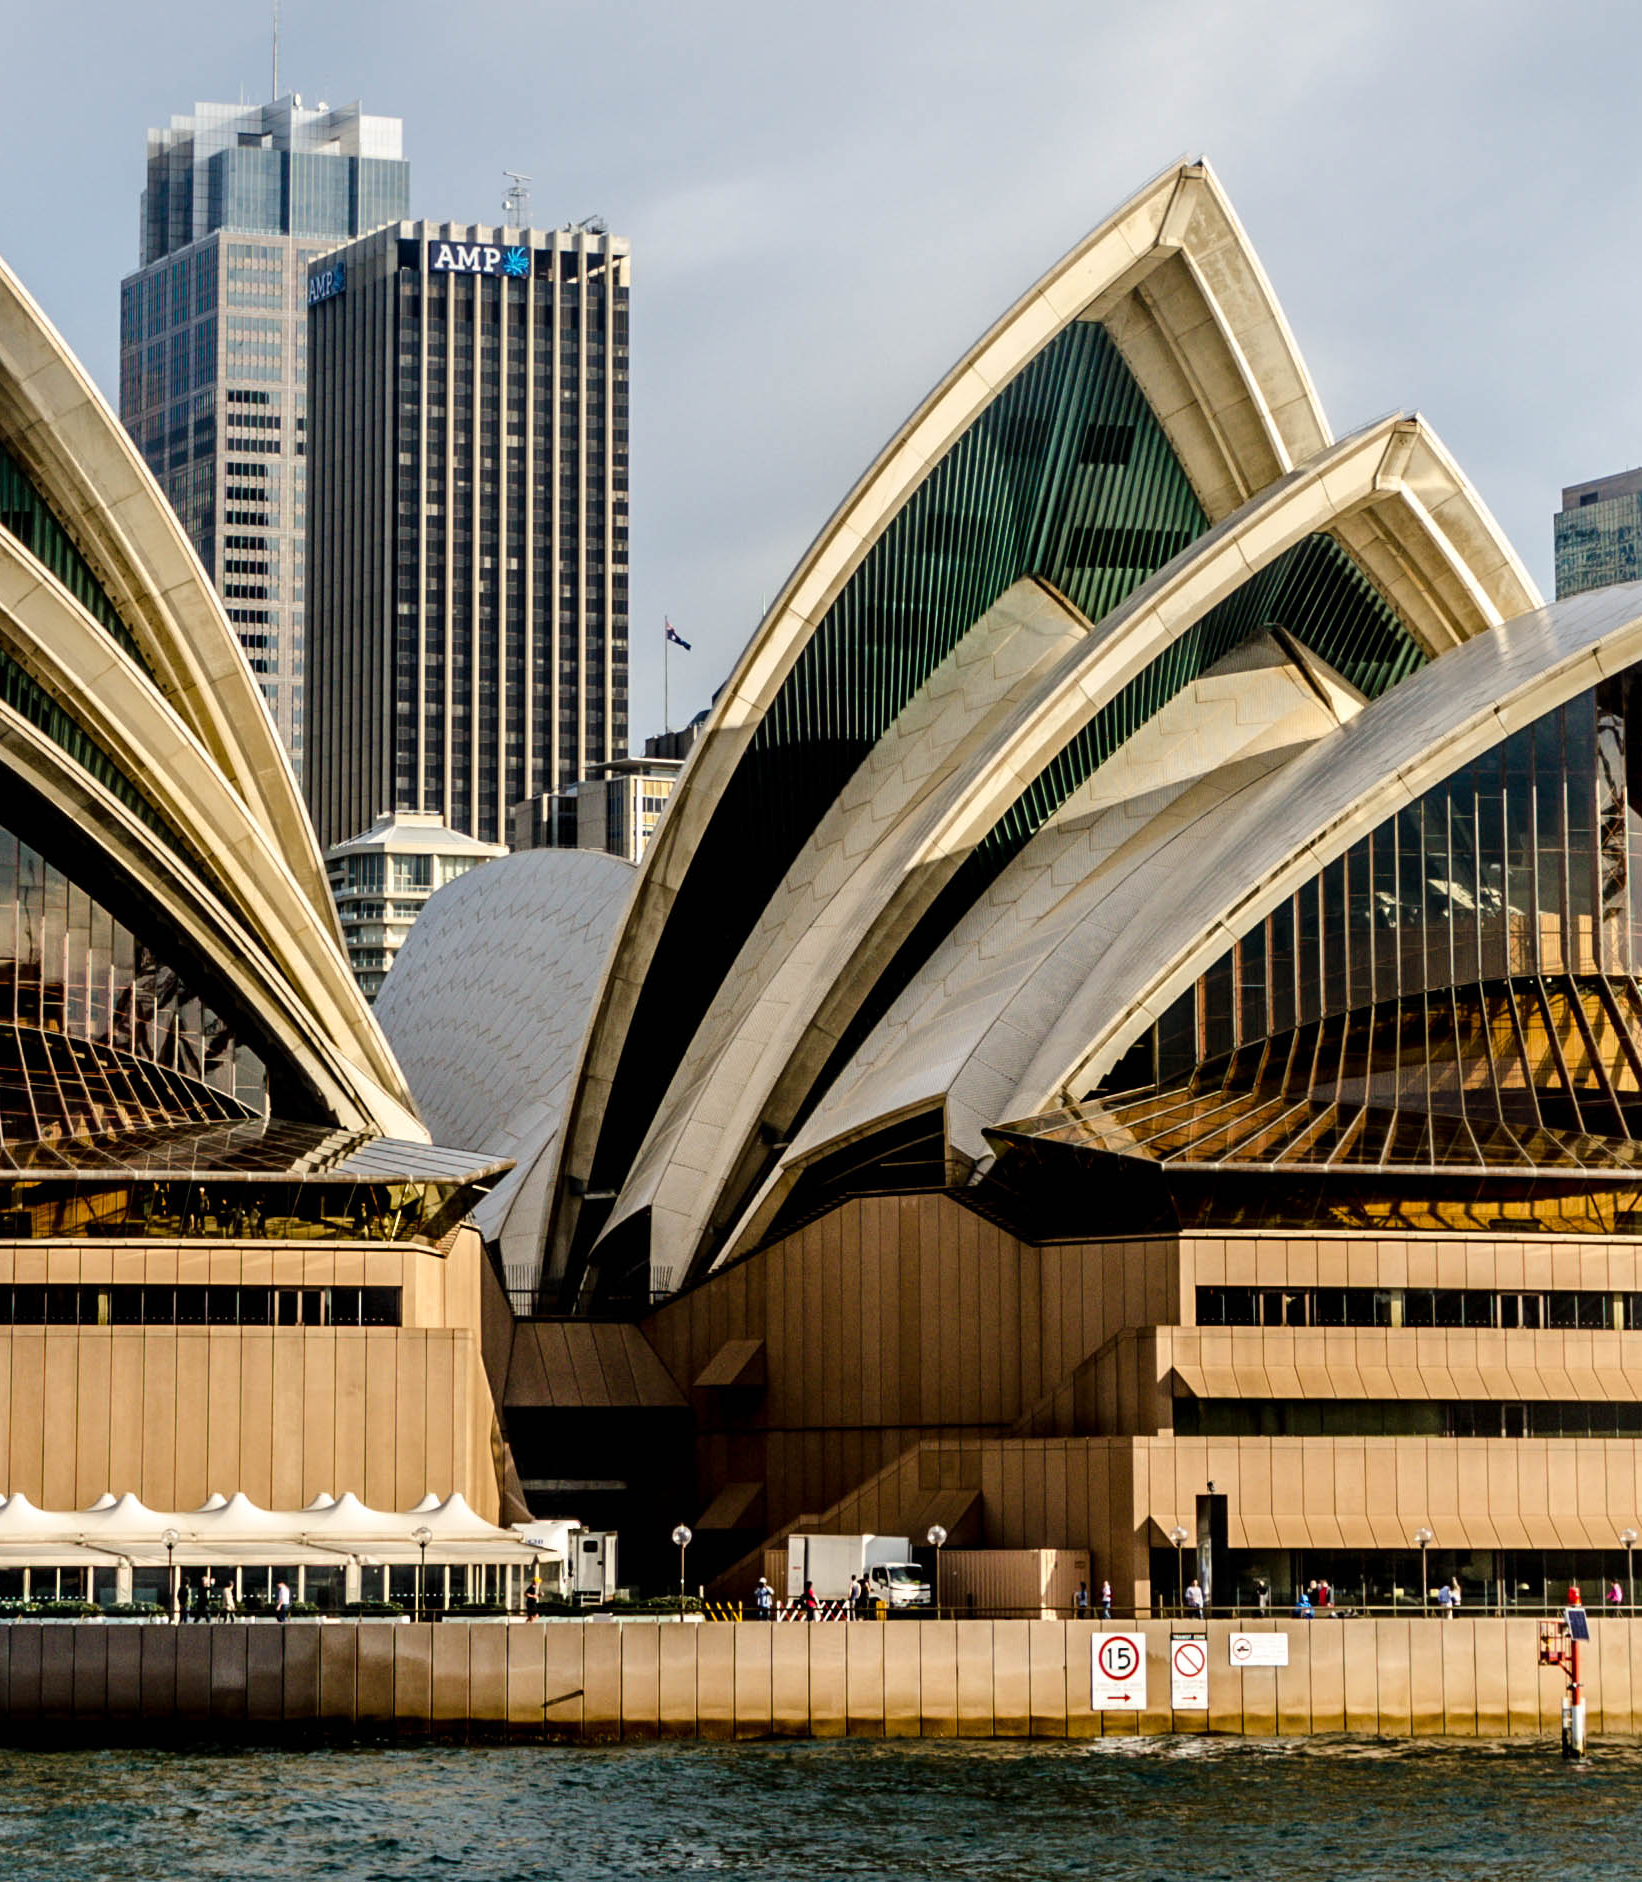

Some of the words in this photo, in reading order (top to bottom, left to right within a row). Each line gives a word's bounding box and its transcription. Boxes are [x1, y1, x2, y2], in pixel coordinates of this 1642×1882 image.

[434, 244, 501, 272] AMP
[308, 271, 333, 300] AMP
[1107, 1648, 1131, 1670] 15
